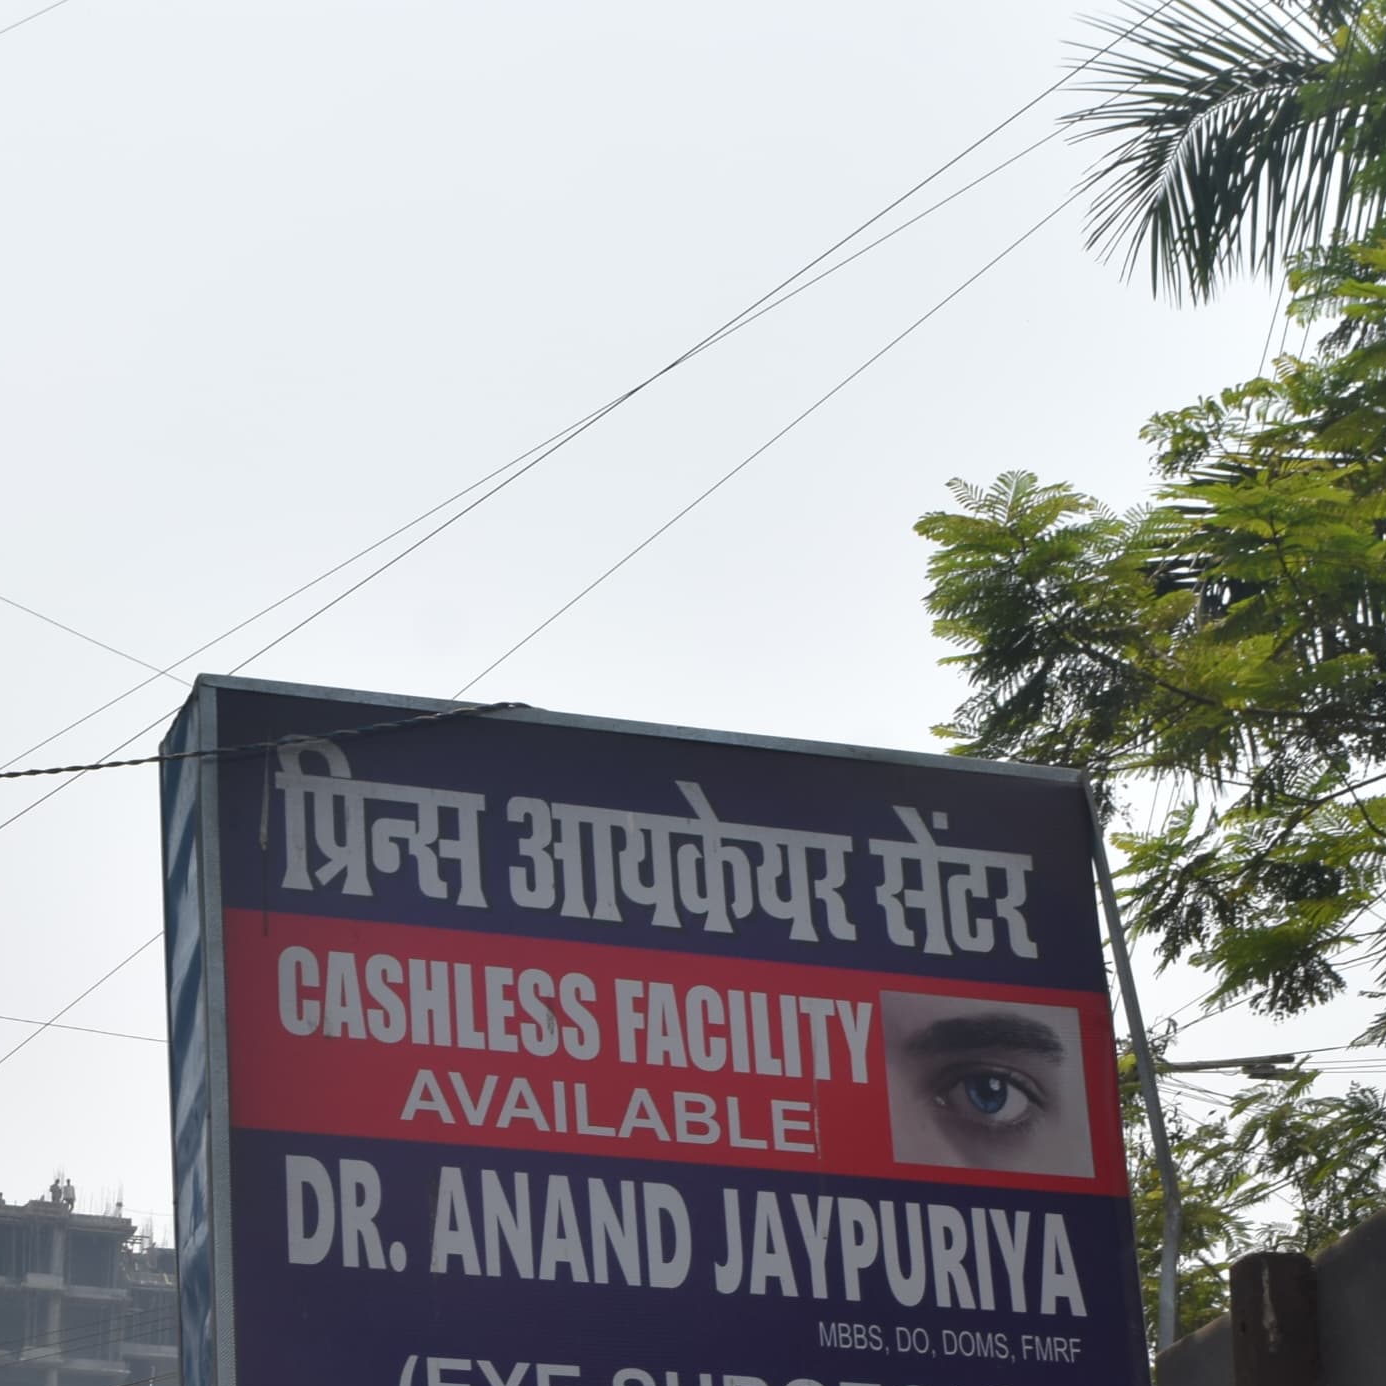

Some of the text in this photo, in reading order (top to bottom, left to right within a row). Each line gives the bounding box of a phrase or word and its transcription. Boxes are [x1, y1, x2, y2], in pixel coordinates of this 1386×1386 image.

[274, 734, 1038, 958] प्रिन्स आयकेयर सेंटर
[277, 947, 873, 1083] CASHLESS FACILITY
[401, 1069, 817, 1154] AVAILABLE
[285, 1154, 1087, 1316] DR. ANAND JAYPURIYA
[818, 1321, 1082, 1362] MBBS, DO, DOMS, FMRF
